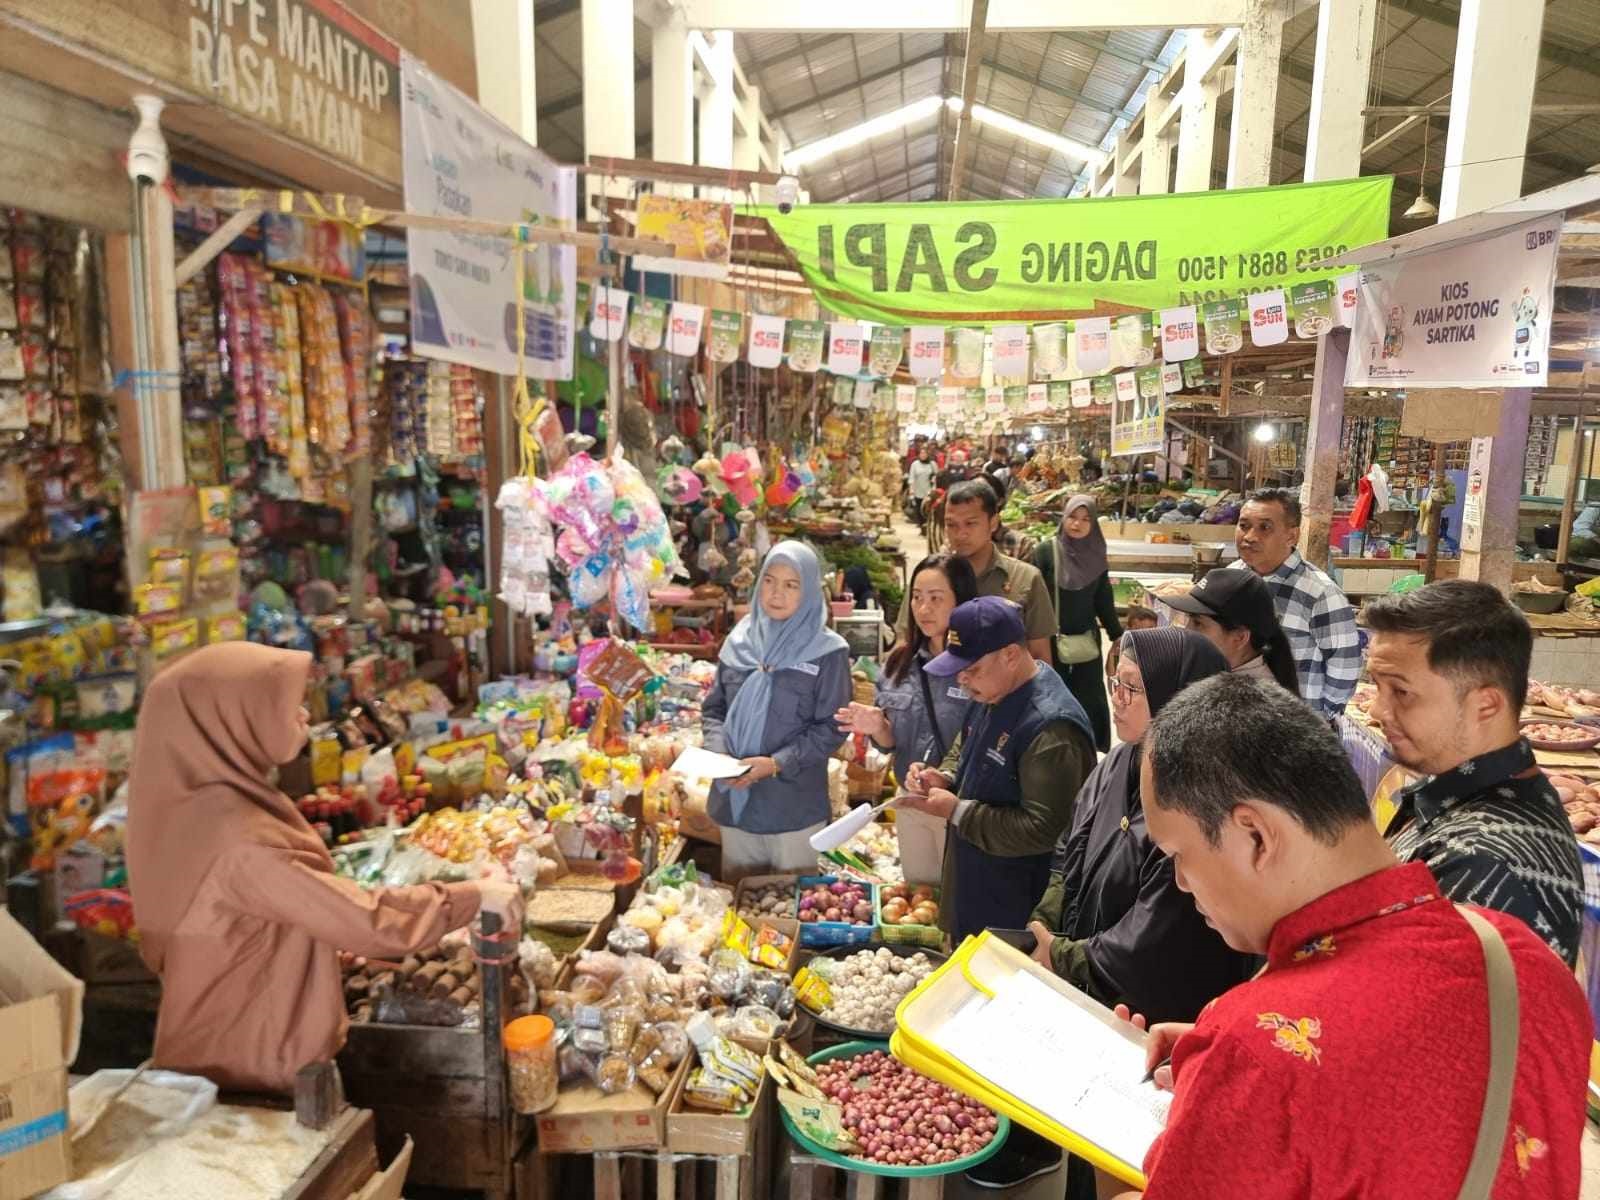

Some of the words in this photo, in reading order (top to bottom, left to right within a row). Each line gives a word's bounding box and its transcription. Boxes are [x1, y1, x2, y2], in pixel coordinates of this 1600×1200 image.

[277, 0, 389, 114] MANTAP
[189, 16, 283, 124] RASA
[290, 73, 363, 164] AYAM
[1440, 281, 1469, 302] KIOS
[1412, 308, 1444, 326] AYAM
[1446, 299, 1500, 322] POTONG
[1426, 324, 1476, 345] SARTIKA
